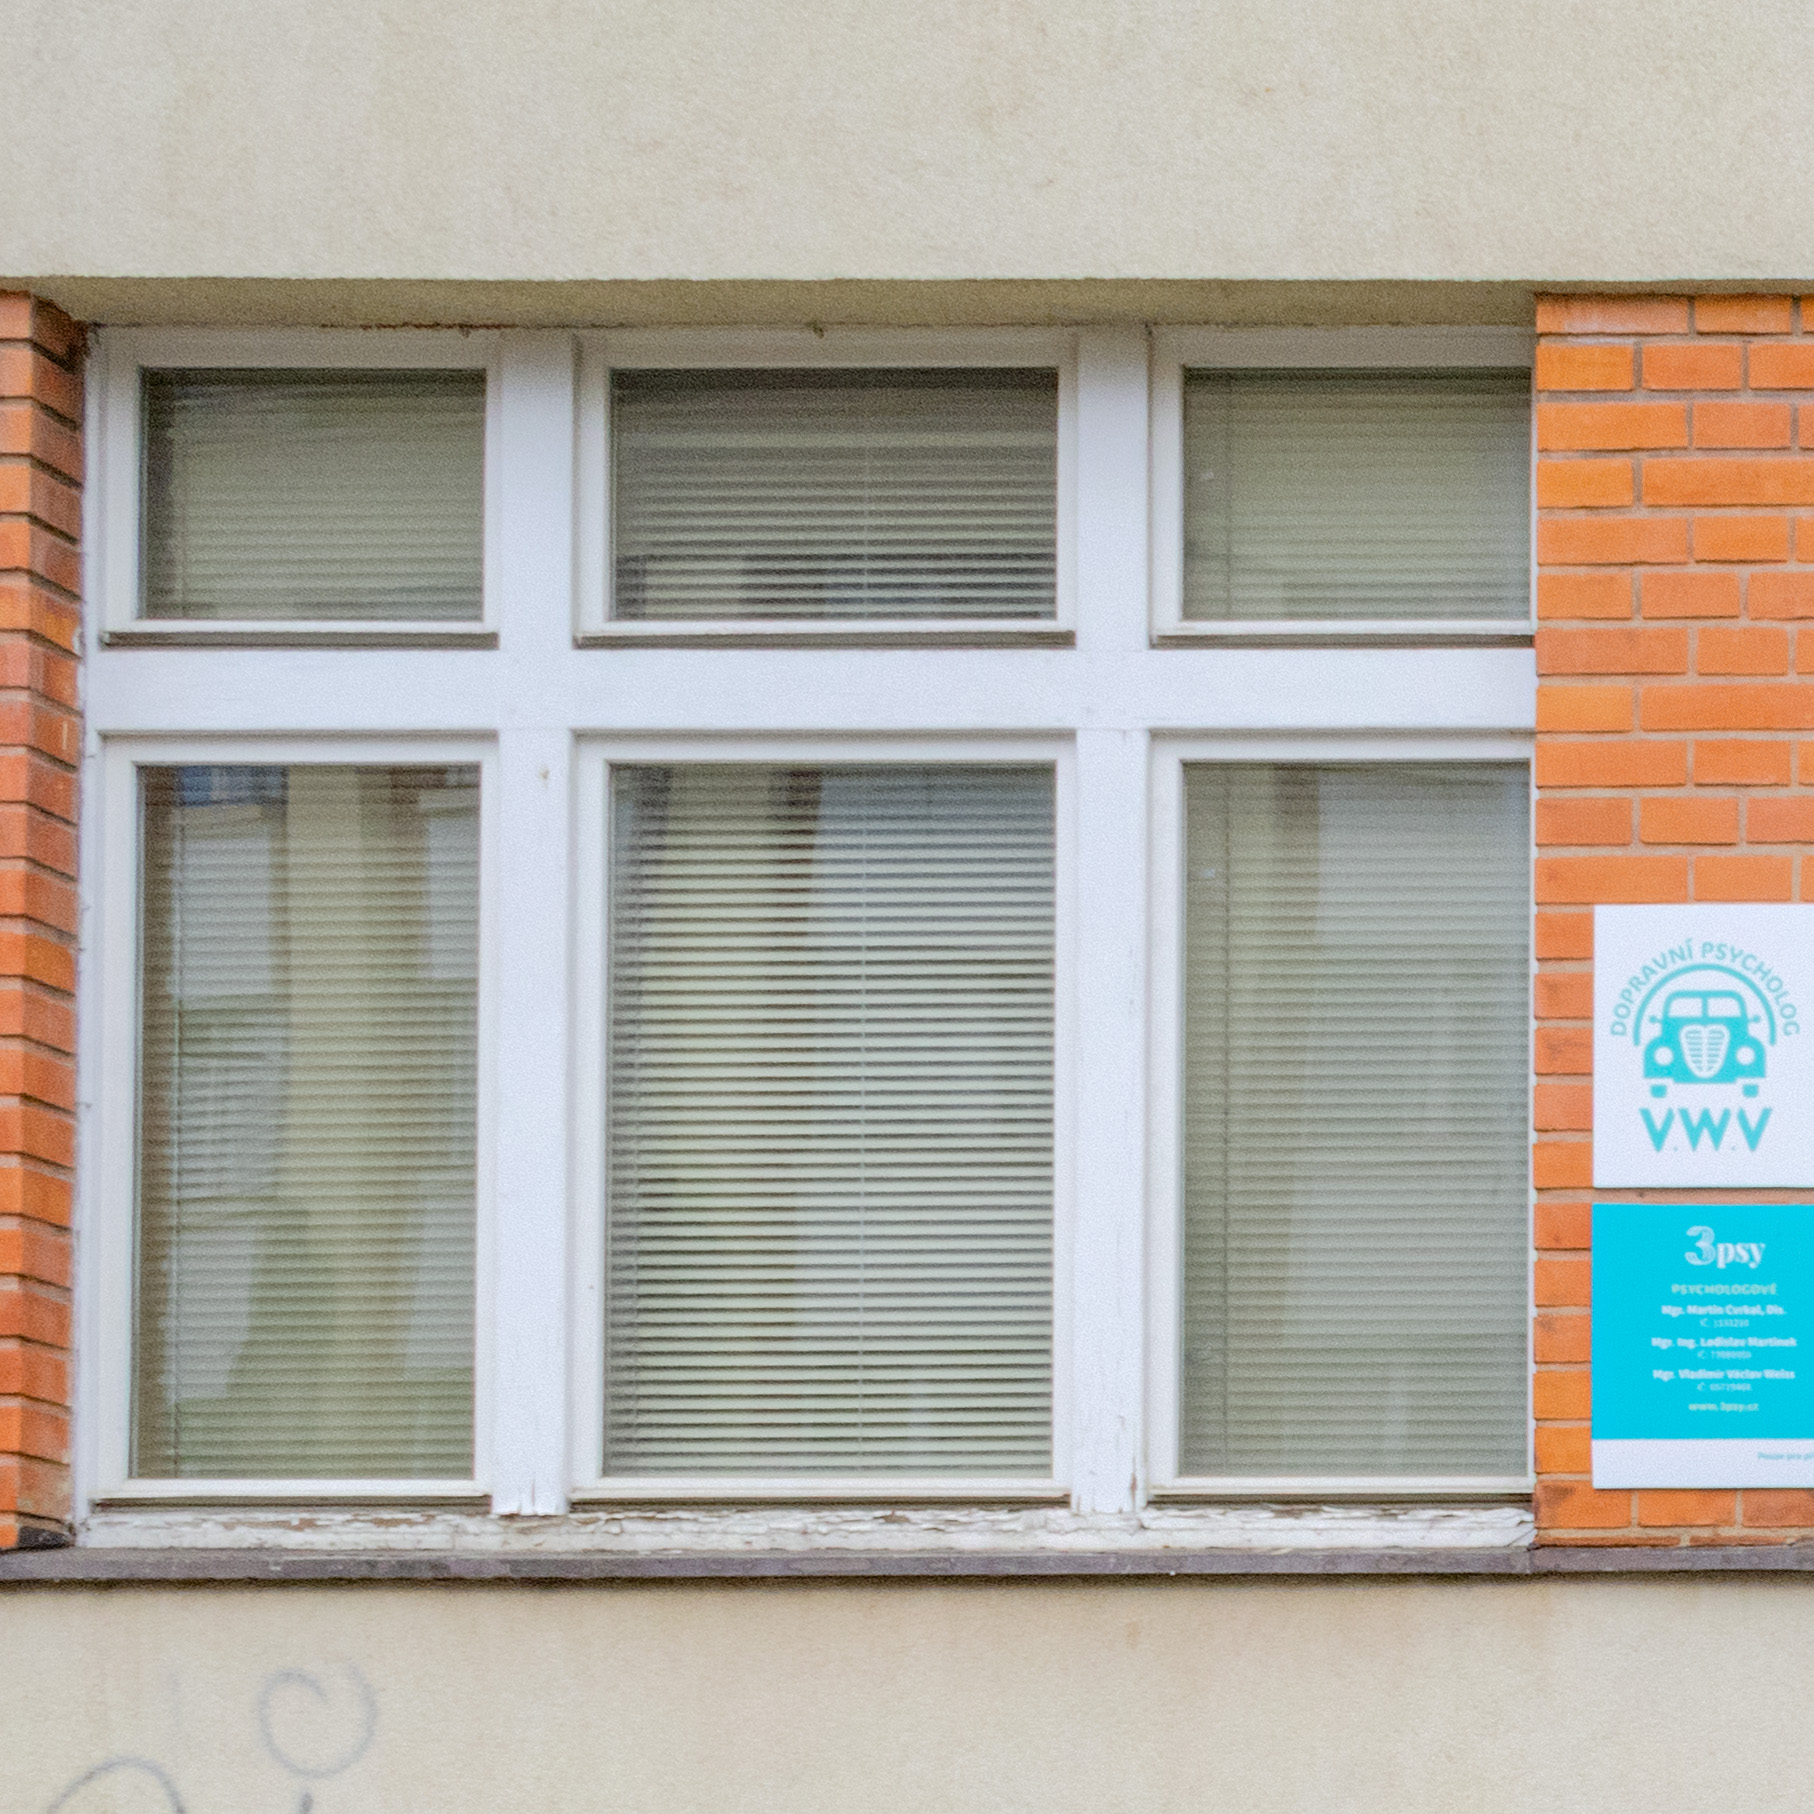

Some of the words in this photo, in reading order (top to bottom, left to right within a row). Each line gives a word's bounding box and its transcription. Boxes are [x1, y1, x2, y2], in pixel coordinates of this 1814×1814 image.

[1611, 938, 1694, 1036] DOPRAVNÍ
[1701, 941, 1800, 1036] PSYCHOLOG
[1684, 1225, 1766, 1269] 3psy
[1670, 1282, 1778, 1296] PSYCHOLOGOVÉ
